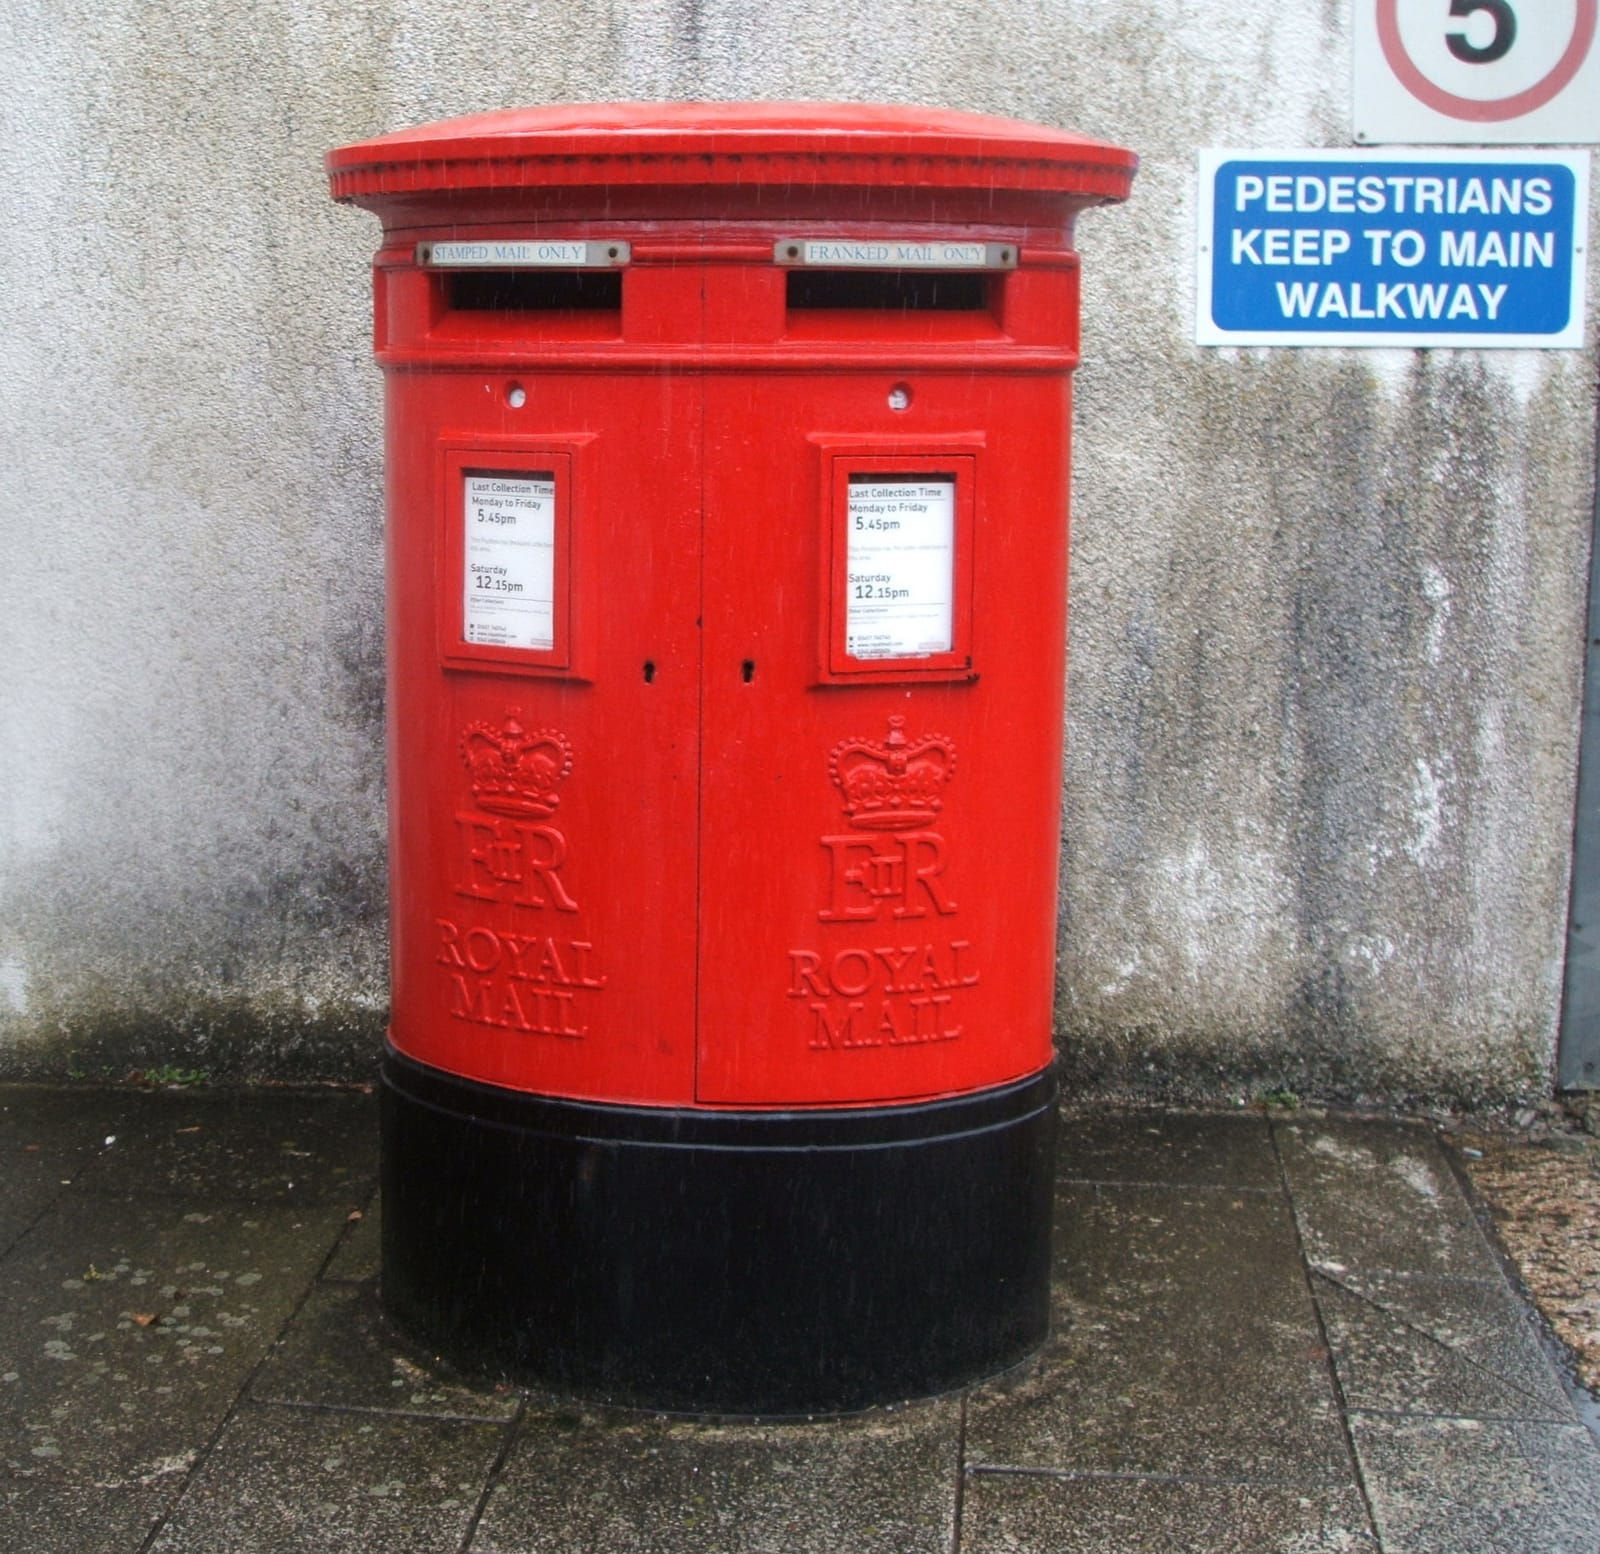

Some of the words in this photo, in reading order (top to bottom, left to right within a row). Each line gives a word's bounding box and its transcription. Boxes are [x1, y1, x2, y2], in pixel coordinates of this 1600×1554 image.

[1445, 0, 1518, 64] 5
[1235, 175, 1553, 216] PEDESTRIANS
[434, 246, 488, 260] STAMPED
[494, 246, 530, 260] MAIL
[538, 246, 582, 260] ONLY
[809, 245, 888, 261] FRANKED
[897, 246, 935, 261] MAIL
[943, 247, 984, 261] ONLY
[1231, 228, 1351, 265] KEEP
[1364, 230, 1426, 266] TO
[1440, 231, 1555, 267] MAIN
[1275, 282, 1508, 320] WALKWAY
[472, 482, 489, 491] Last
[491, 483, 531, 494] Collection
[849, 488, 869, 498] Last
[871, 488, 917, 498] Collection
[918, 487, 942, 497] Time
[472, 497, 503, 508] Monday
[505, 499, 514, 507] to
[515, 499, 542, 510] Friday
[849, 504, 885, 514] Monday
[887, 504, 897, 512] to
[899, 503, 929, 513] Friday
[477, 508, 517, 525] 5.45pm
[855, 516, 901, 531] 5.45pm
[470, 563, 508, 576] Saturday
[476, 575, 524, 592] 12.15pm
[849, 573, 891, 583] Saturday
[855, 584, 910, 600] 12.15pm
[435, 918, 607, 991] ROYAL
[787, 940, 980, 998] ROYAL
[450, 973, 590, 1039] MAIL
[809, 994, 964, 1050] MAIL
